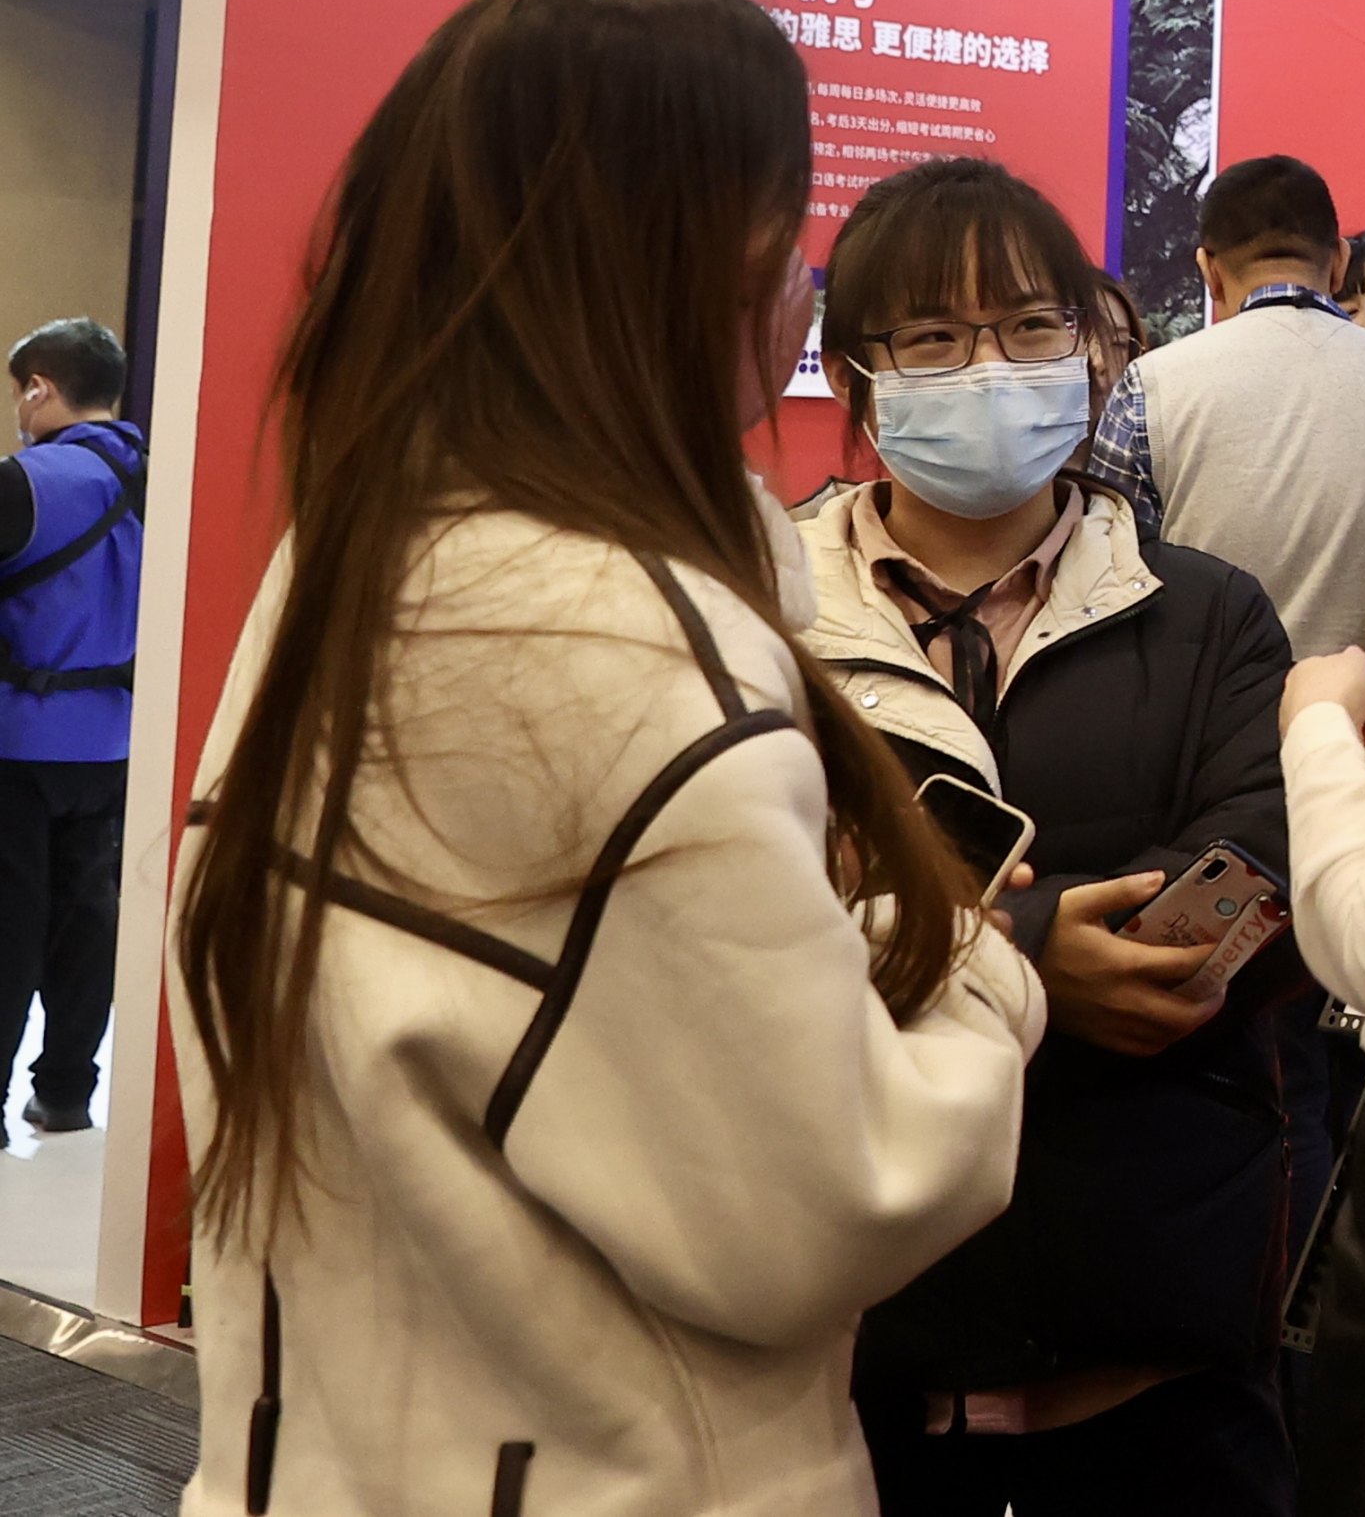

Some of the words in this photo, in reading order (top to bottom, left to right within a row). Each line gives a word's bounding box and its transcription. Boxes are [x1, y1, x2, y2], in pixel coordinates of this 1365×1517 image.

[760, 6, 863, 52] 的雅思
[871, 20, 1050, 75] 更便捷的选择
